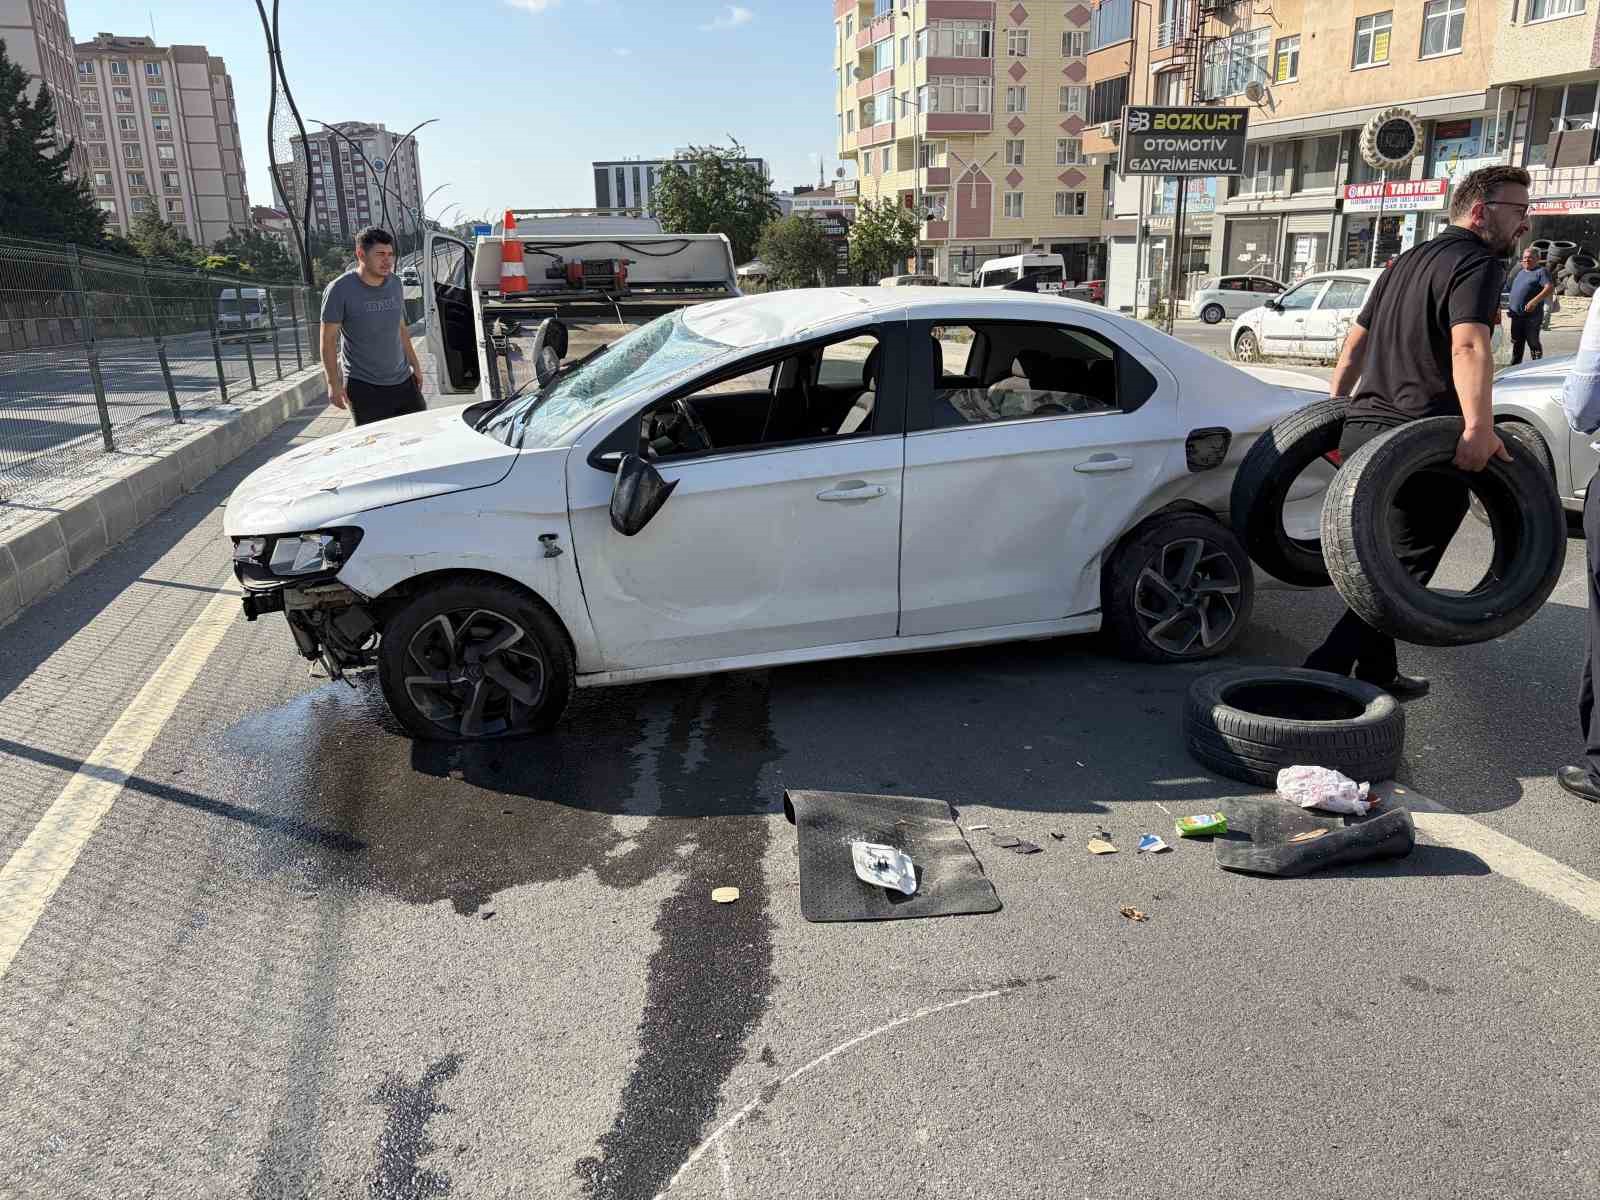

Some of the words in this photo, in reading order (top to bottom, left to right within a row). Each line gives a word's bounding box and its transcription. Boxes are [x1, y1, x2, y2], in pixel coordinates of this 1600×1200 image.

[1153, 113, 1244, 131] BOZKURT
[1143, 136, 1228, 152] OTOMOTİV
[1129, 156, 1237, 171] GAYRİMENKUL
